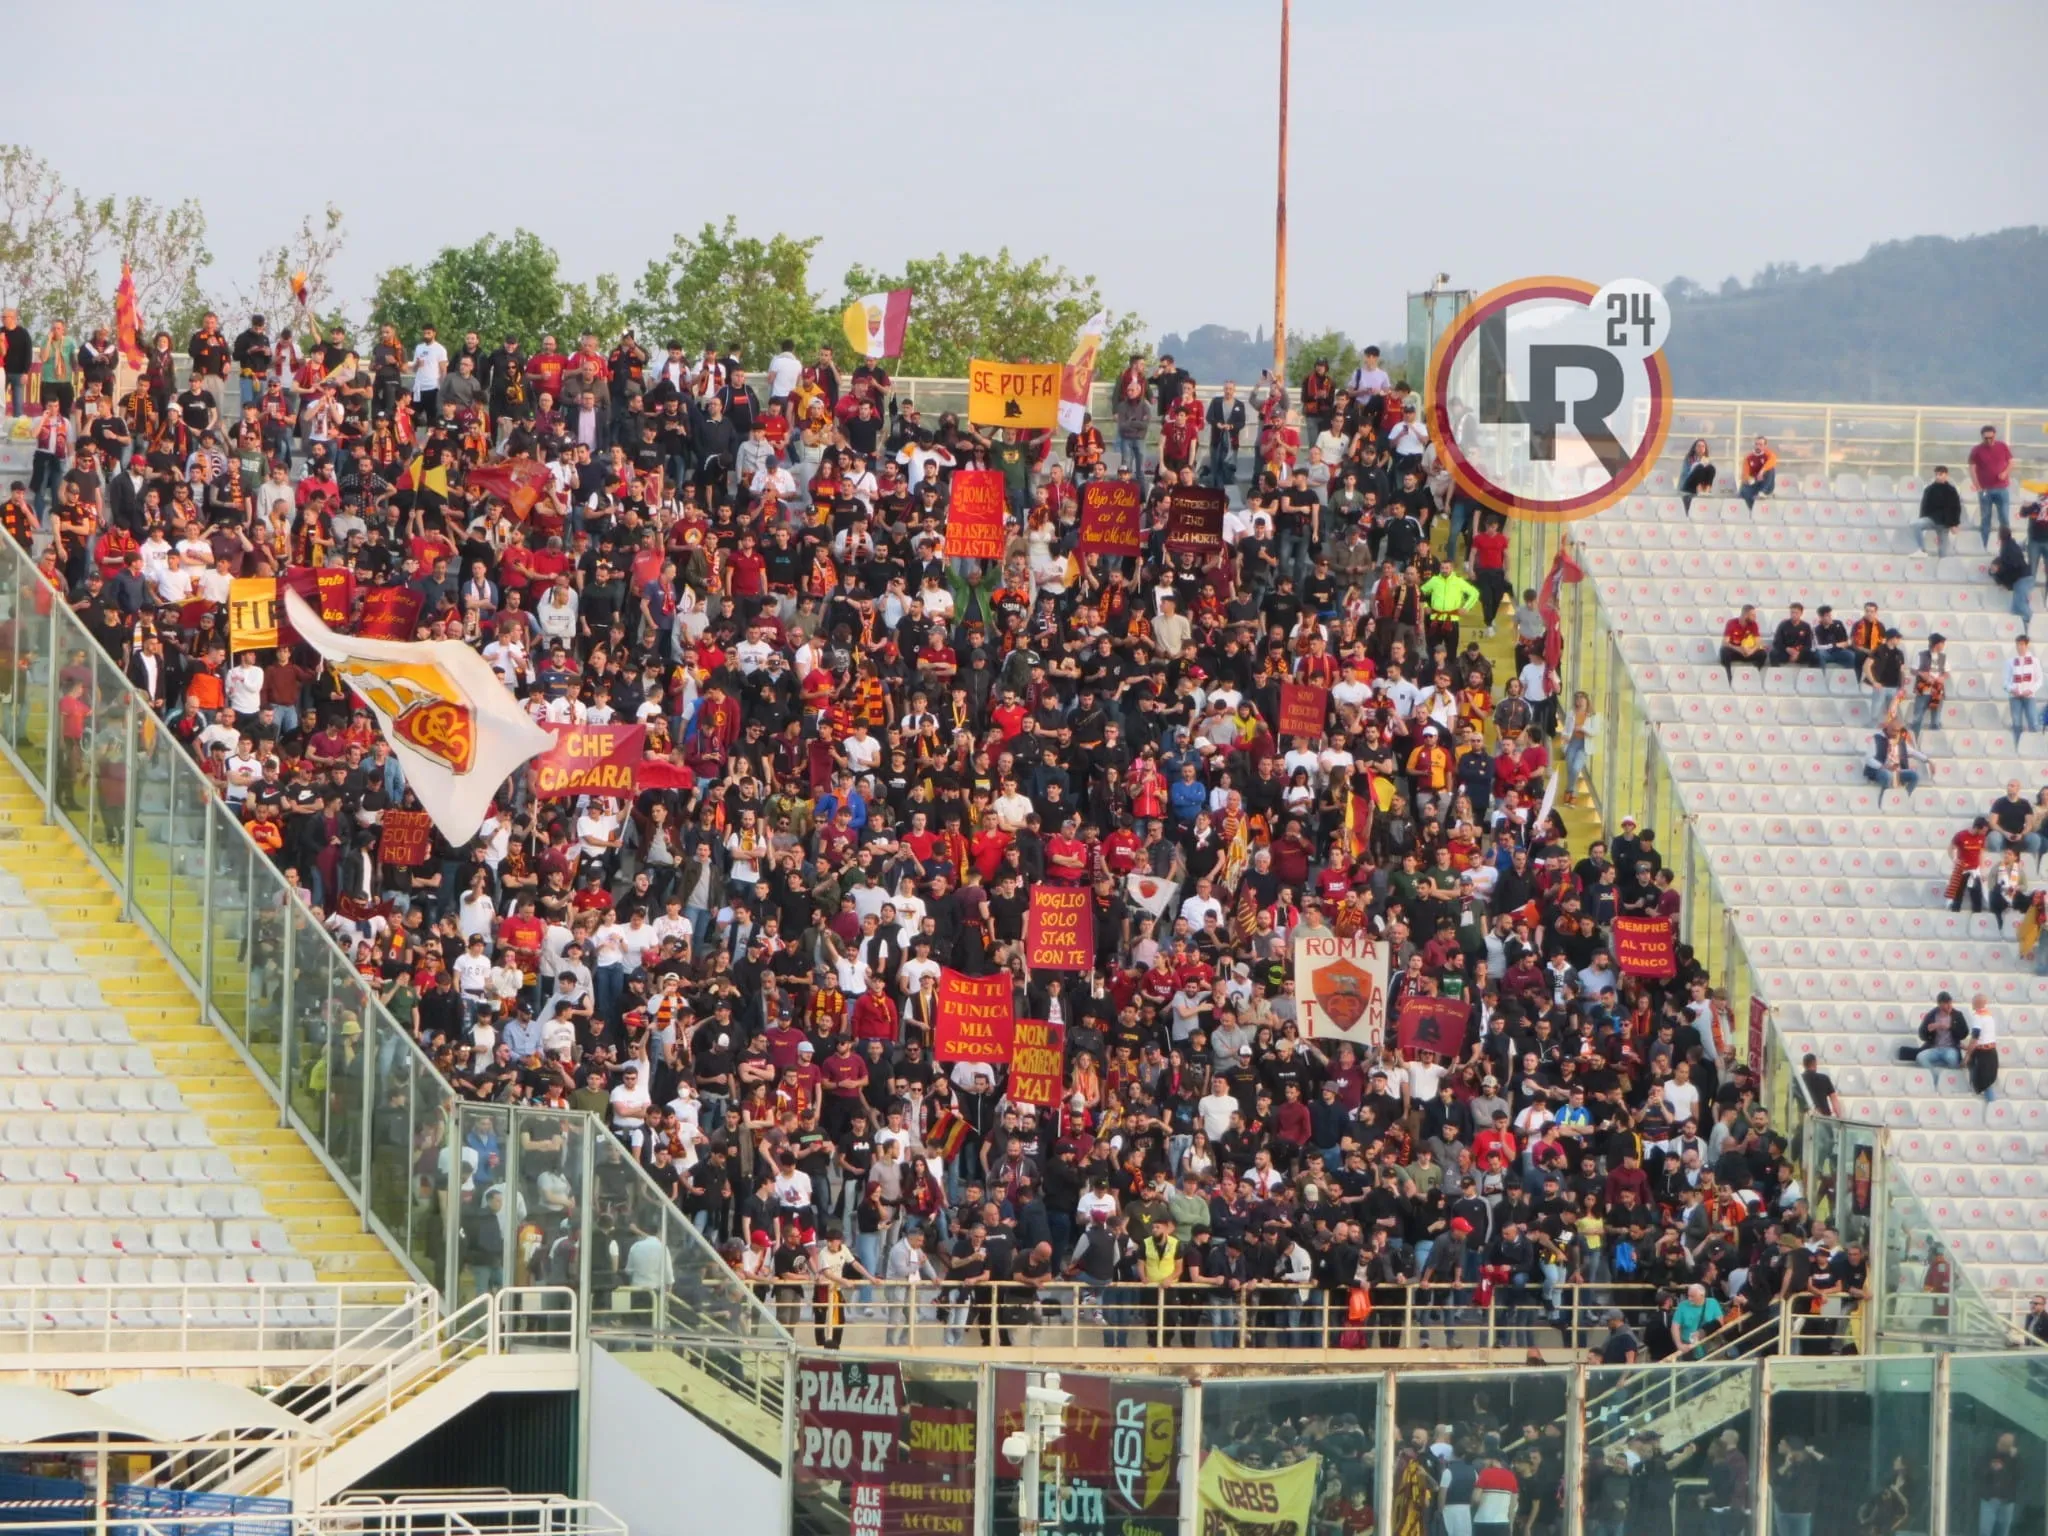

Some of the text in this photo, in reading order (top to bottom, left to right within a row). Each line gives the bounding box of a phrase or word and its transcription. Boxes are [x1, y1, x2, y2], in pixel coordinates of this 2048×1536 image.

[974, 370, 993, 394] SE
[567, 733, 614, 758] CHE
[383, 828, 424, 844] SOLO
[384, 846, 411, 862] NOI
[1035, 890, 1085, 909] VOGLIO
[1040, 911, 1077, 927] SOLO
[1616, 920, 1669, 933] SEMPRE
[1040, 930, 1076, 946] STAR
[1306, 937, 1376, 959] ROMA
[1620, 939, 1667, 952] AL TUO
[1033, 949, 1085, 965] CON TE
[1620, 956, 1668, 968] FIANCO
[949, 980, 1004, 997] SEI TU
[944, 1001, 1009, 1018] L'UNICA
[1302, 1000, 1317, 1037] TI
[1369, 986, 1383, 1048] AMO
[960, 1022, 993, 1038] MIA
[1013, 1024, 1048, 1046] NON
[944, 1040, 1004, 1055] SPOSA
[1013, 1076, 1052, 1102] MAI
[800, 1370, 898, 1416] PIAZZA
[910, 1420, 976, 1452] SIMONE
[803, 1426, 892, 1472] PIO IX
[1113, 1398, 1147, 1510] ASR
[856, 1486, 881, 1506] ALE
[1217, 1475, 1279, 1513] URBS
[853, 1507, 882, 1527] CON
